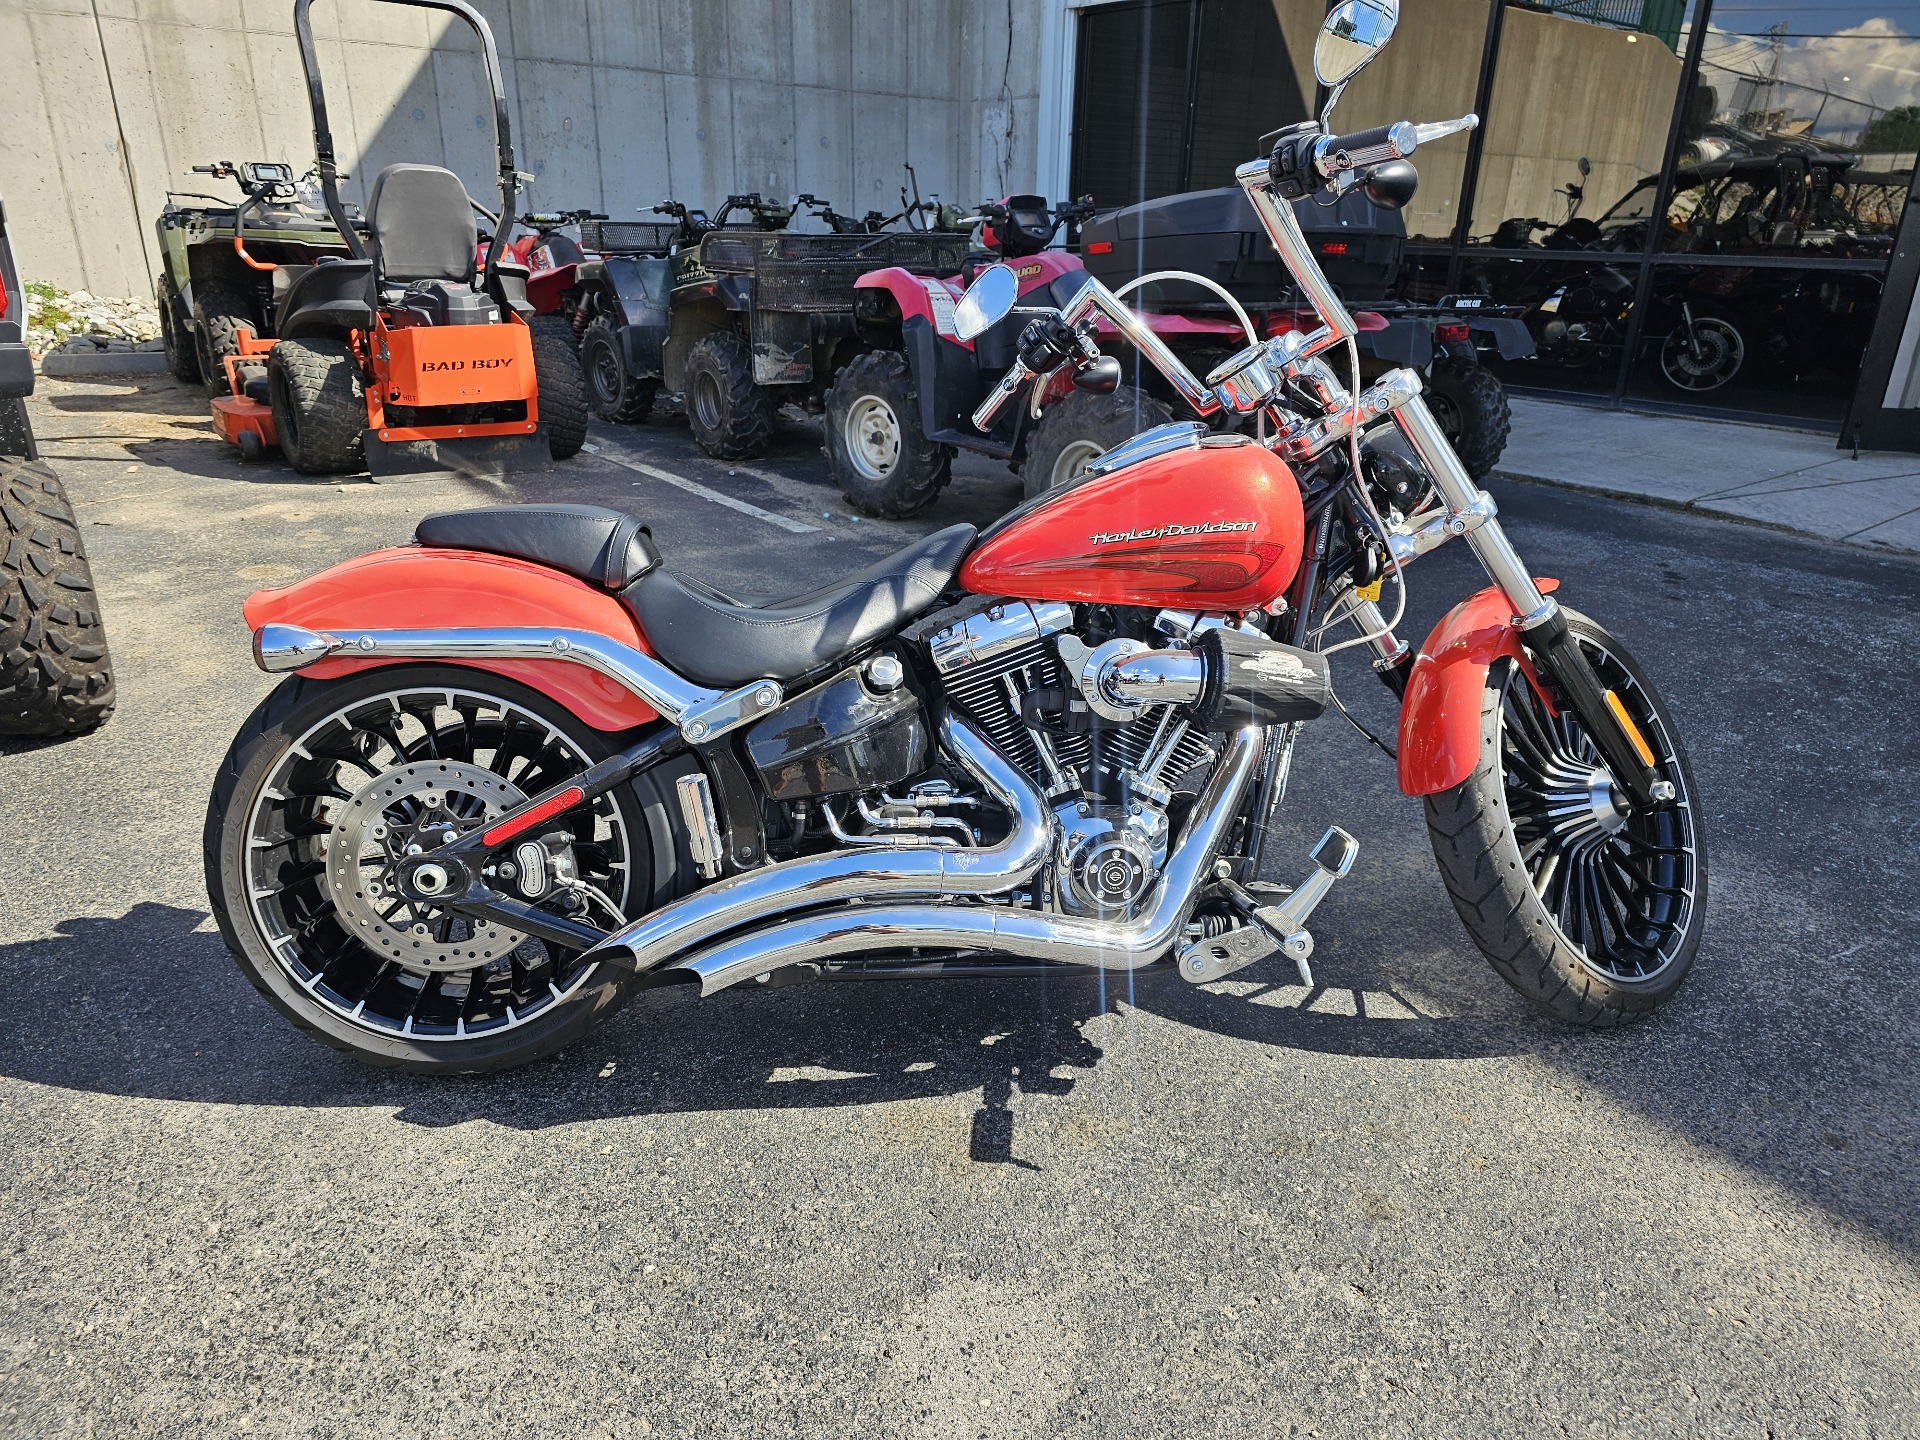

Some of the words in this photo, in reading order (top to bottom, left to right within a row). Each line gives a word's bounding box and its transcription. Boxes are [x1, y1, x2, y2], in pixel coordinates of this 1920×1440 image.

[1014, 264, 1042, 277] UAD
[422, 360, 464, 372] BAD
[472, 358, 513, 370] BOY
[1089, 520, 1257, 545] Harley-Davidson
